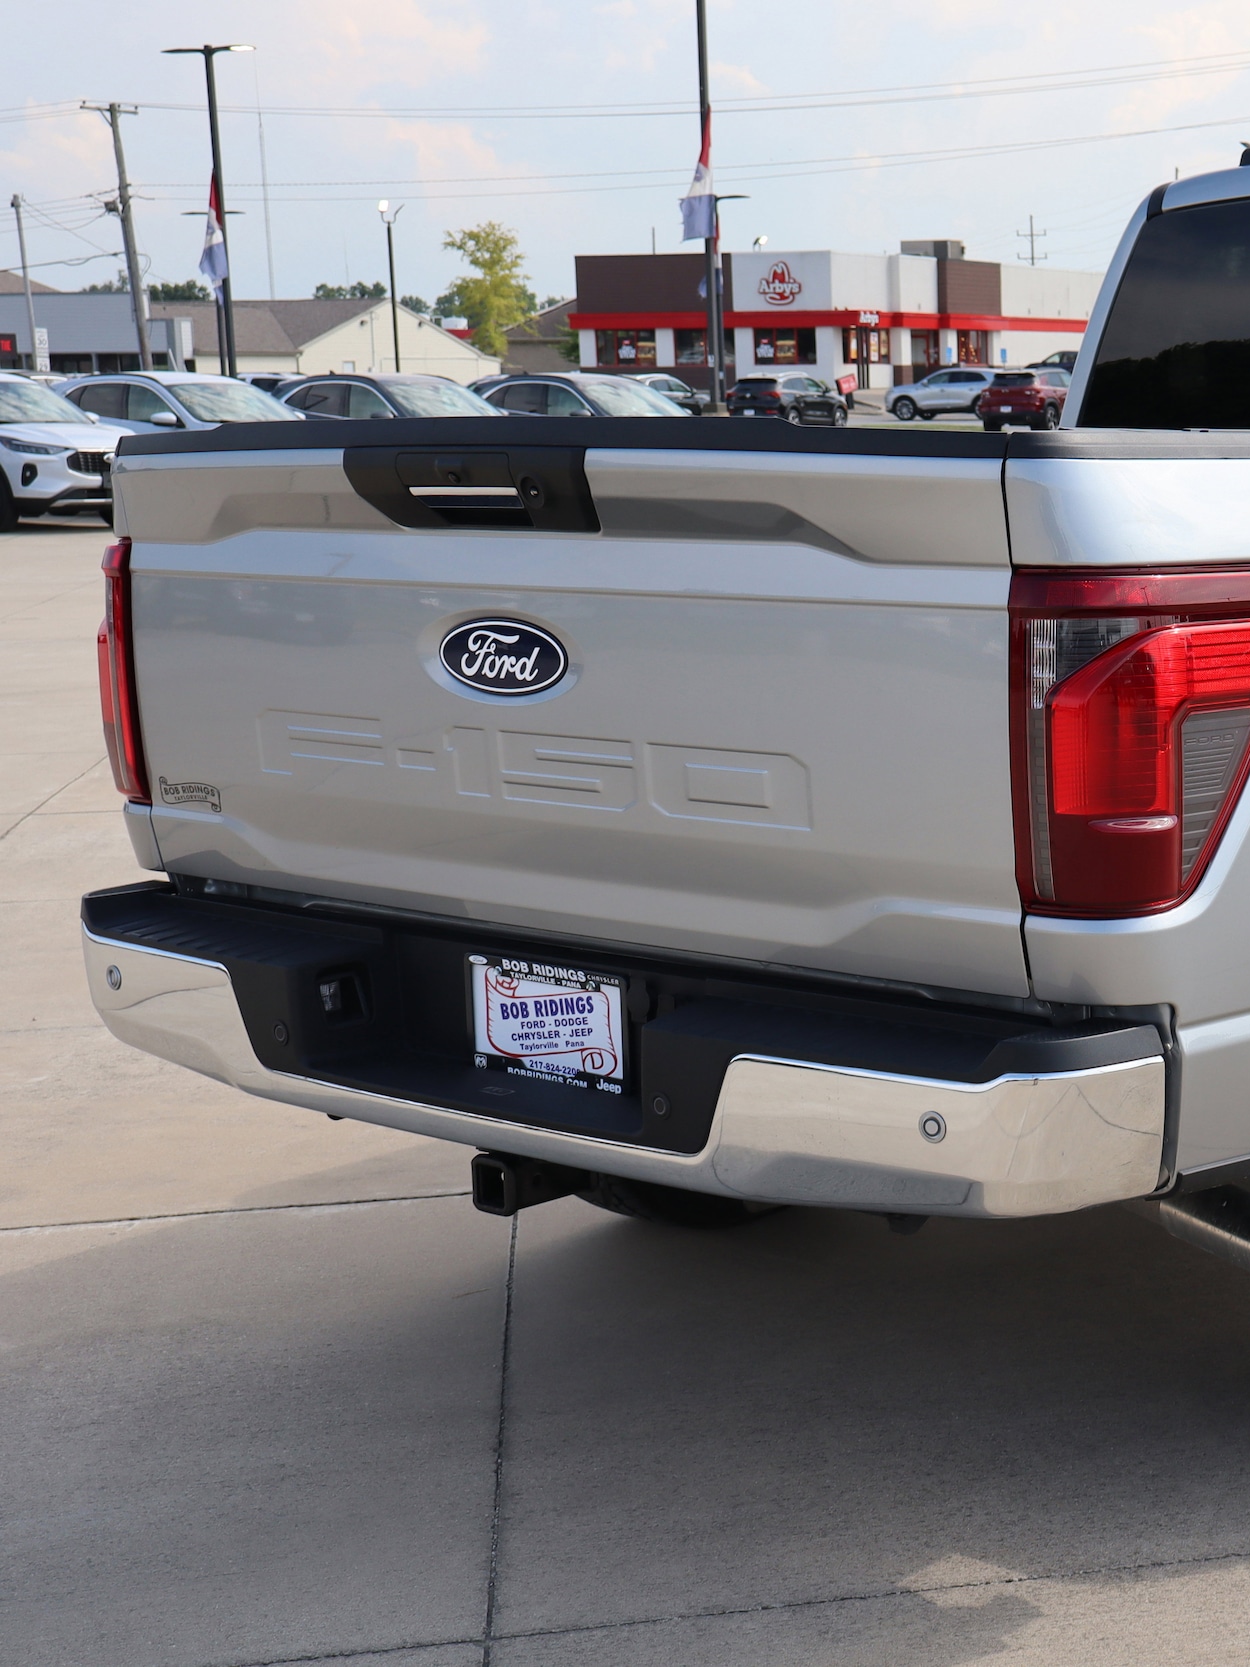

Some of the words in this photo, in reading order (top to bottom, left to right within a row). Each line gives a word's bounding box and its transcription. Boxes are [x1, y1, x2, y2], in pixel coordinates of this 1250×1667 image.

[760, 278, 800, 297] Arby's
[460, 630, 541, 682] Ford
[1184, 733, 1235, 747] FORD
[256, 708, 812, 831] F-150
[163, 786, 180, 796] BOB
[181, 784, 216, 797] RIDINGS
[501, 958, 529, 973] BOB
[532, 963, 586, 983] RIDINGS
[510, 971, 556, 985] TAYLORVILLE
[561, 980, 581, 989] PANA
[586, 974, 620, 985] CHRYSLER
[500, 1000, 530, 1021] BOB
[534, 995, 594, 1018] RIDINGS
[520, 1020, 546, 1030] FORD
[554, 1016, 589, 1028] DODGE
[511, 1029, 561, 1042] CHRYSLER
[569, 1027, 593, 1038] JEEP
[519, 1041, 559, 1052] Taylorville
[565, 1040, 585, 1048] Pana
[507, 1066, 588, 1088] BOBRIDINGSCOM
[596, 1078, 622, 1094] Jeep
